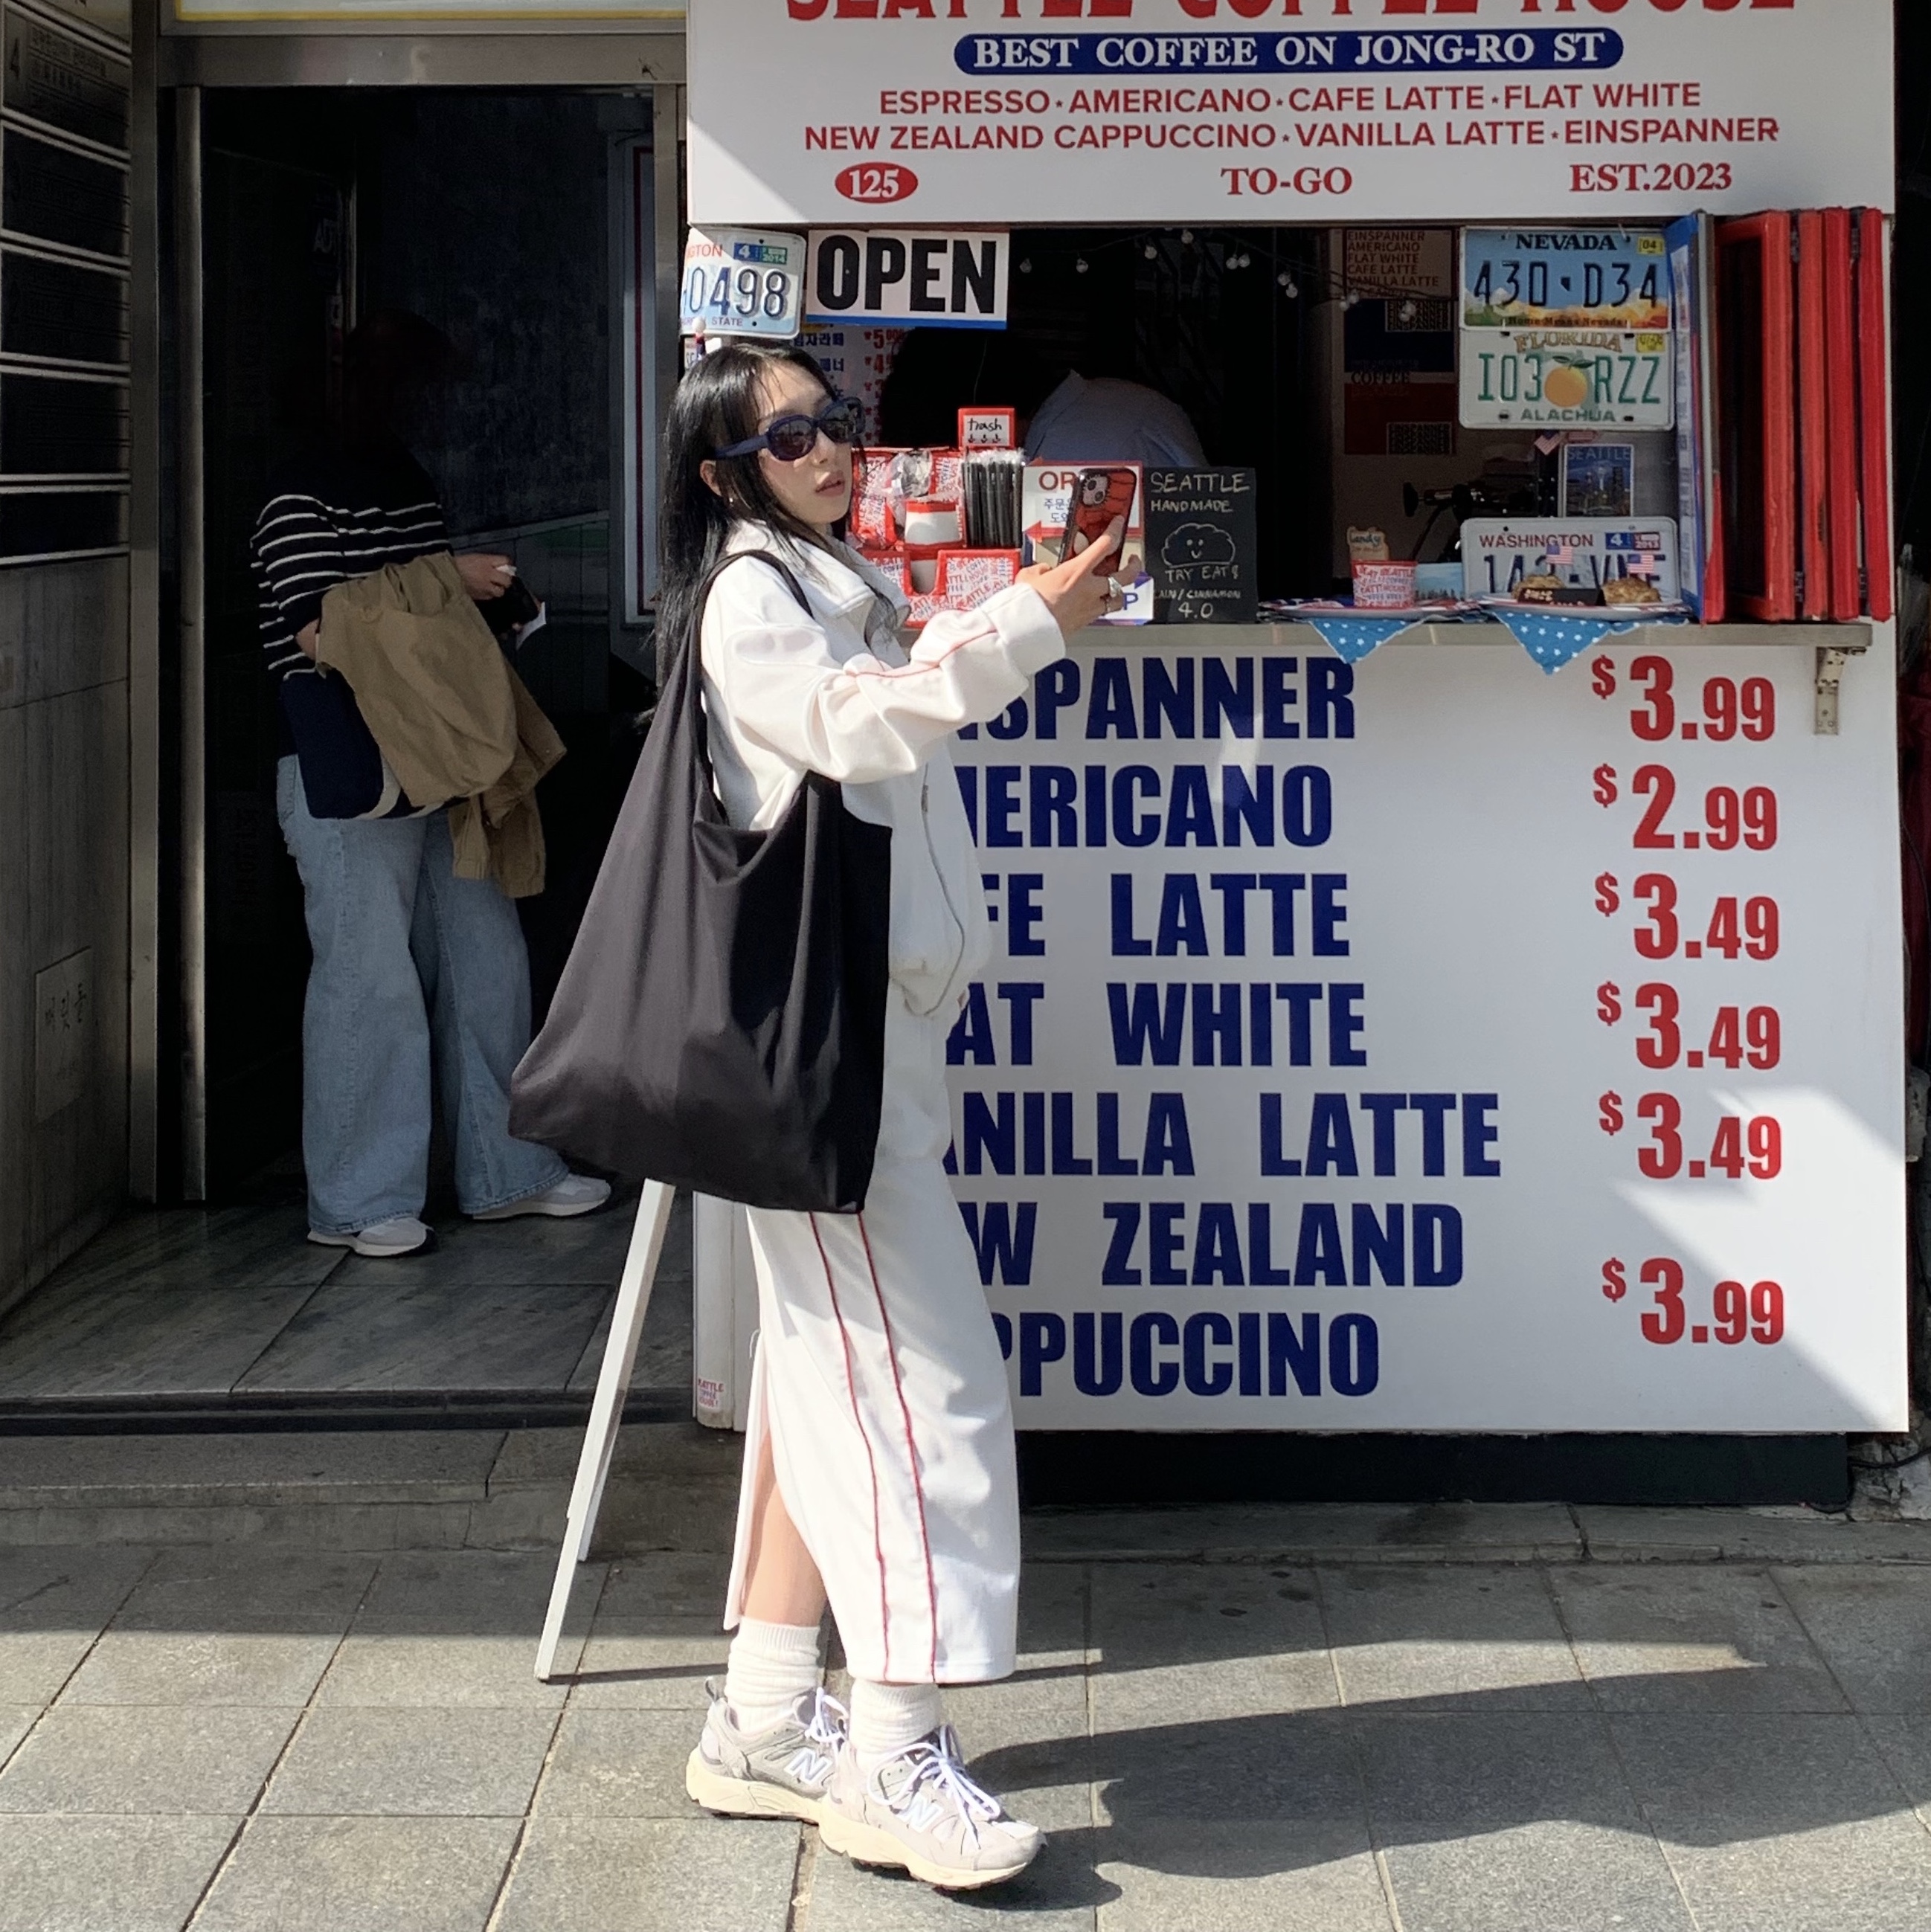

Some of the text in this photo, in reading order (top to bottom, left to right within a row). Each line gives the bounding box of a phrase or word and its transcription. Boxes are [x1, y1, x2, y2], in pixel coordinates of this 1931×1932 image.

[975, 33, 1605, 68] BEST COFFEE ON JONG-RO ST
[880, 82, 1700, 115] ESPRESSO AMERICANO CAFE LATTE FLAT WHITE
[805, 117, 1779, 151] NEW ZEALAND CAPPUCCINO VANILLA LATTE EINSPANNER
[849, 170, 899, 198] 125
[1222, 167, 1353, 196] TO-GO
[1570, 162, 1732, 194] EST.2023
[1347, 231, 1425, 241] EINSPANNER
[1347, 242, 1421, 251] AMERICANO
[1517, 234, 1617, 251] NEVADA
[1347, 265, 1418, 274] CAFE LATTE
[1348, 254, 1420, 263] FLAT WHITE
[817, 235, 997, 315] OPEN
[1401, 276, 1439, 286] LATTE
[1474, 261, 1657, 308] 430 D34
[684, 265, 786, 318] 0498
[712, 317, 744, 326] STATE
[1514, 332, 1622, 353] FLORIDA
[968, 418, 1002, 431] trash
[1520, 409, 1616, 422] ALACHUA
[1567, 448, 1631, 461] SEATTLE
[1151, 471, 1250, 492] SEATTLE
[1151, 499, 1233, 512] HANDMADE
[1479, 534, 1594, 548] WASHINGTON
[1164, 568, 1194, 583] TRY
[1177, 601, 1214, 619] 4.0
[1592, 654, 1776, 742] $3.99
[1593, 763, 1779, 851] $2.99
[1111, 873, 1351, 957] LATTE
[1595, 872, 1780, 962] $3.49
[1107, 983, 1367, 1067] WHITE
[1596, 981, 1781, 1071] $3.49
[943, 1090, 1783, 1181] NILLA LATTE $3.49
[1102, 1202, 1464, 1287] ZEALAND
[1601, 1257, 1786, 1345] $3.99
